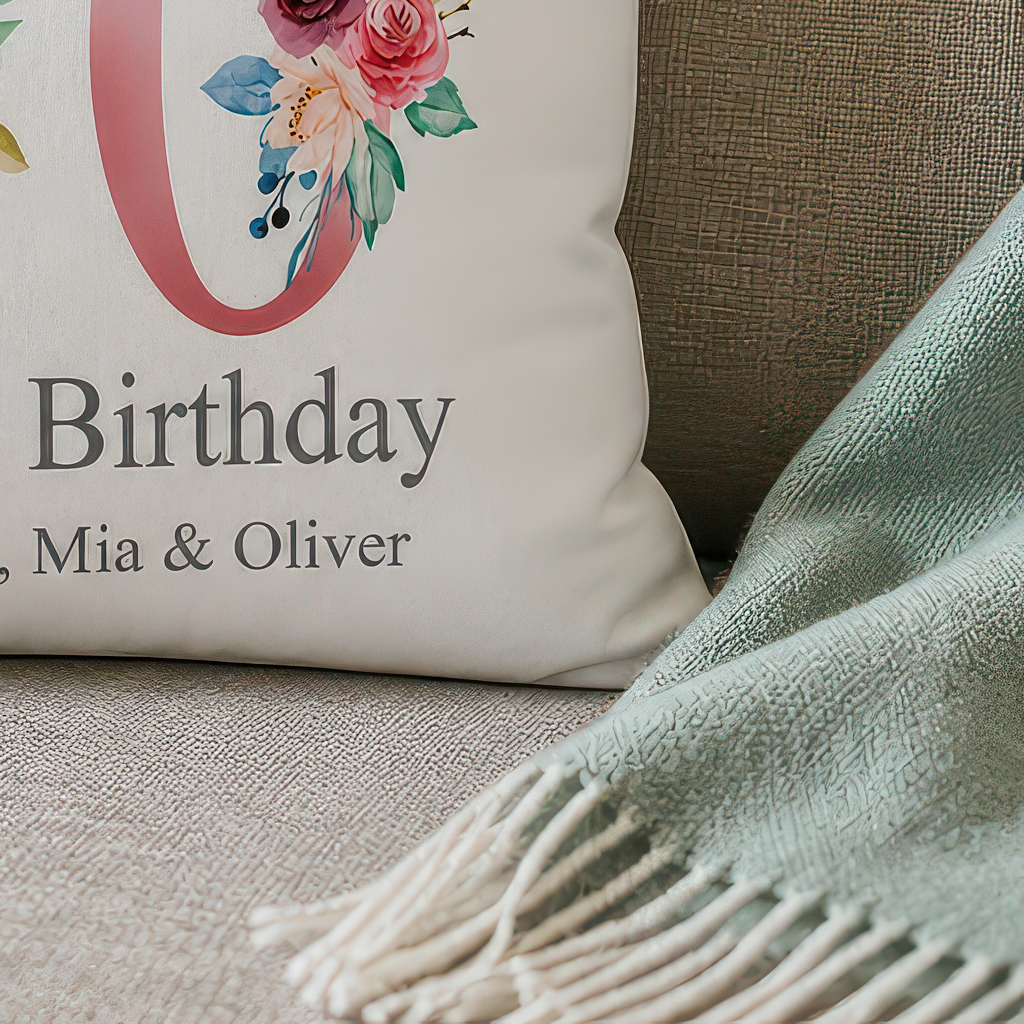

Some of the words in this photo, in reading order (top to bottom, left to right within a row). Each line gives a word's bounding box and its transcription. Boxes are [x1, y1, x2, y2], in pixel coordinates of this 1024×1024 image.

[27, 365, 456, 489] Birthday
[31, 523, 145, 576] Mia
[163, 522, 214, 572] &
[234, 518, 412, 571] Oliver
